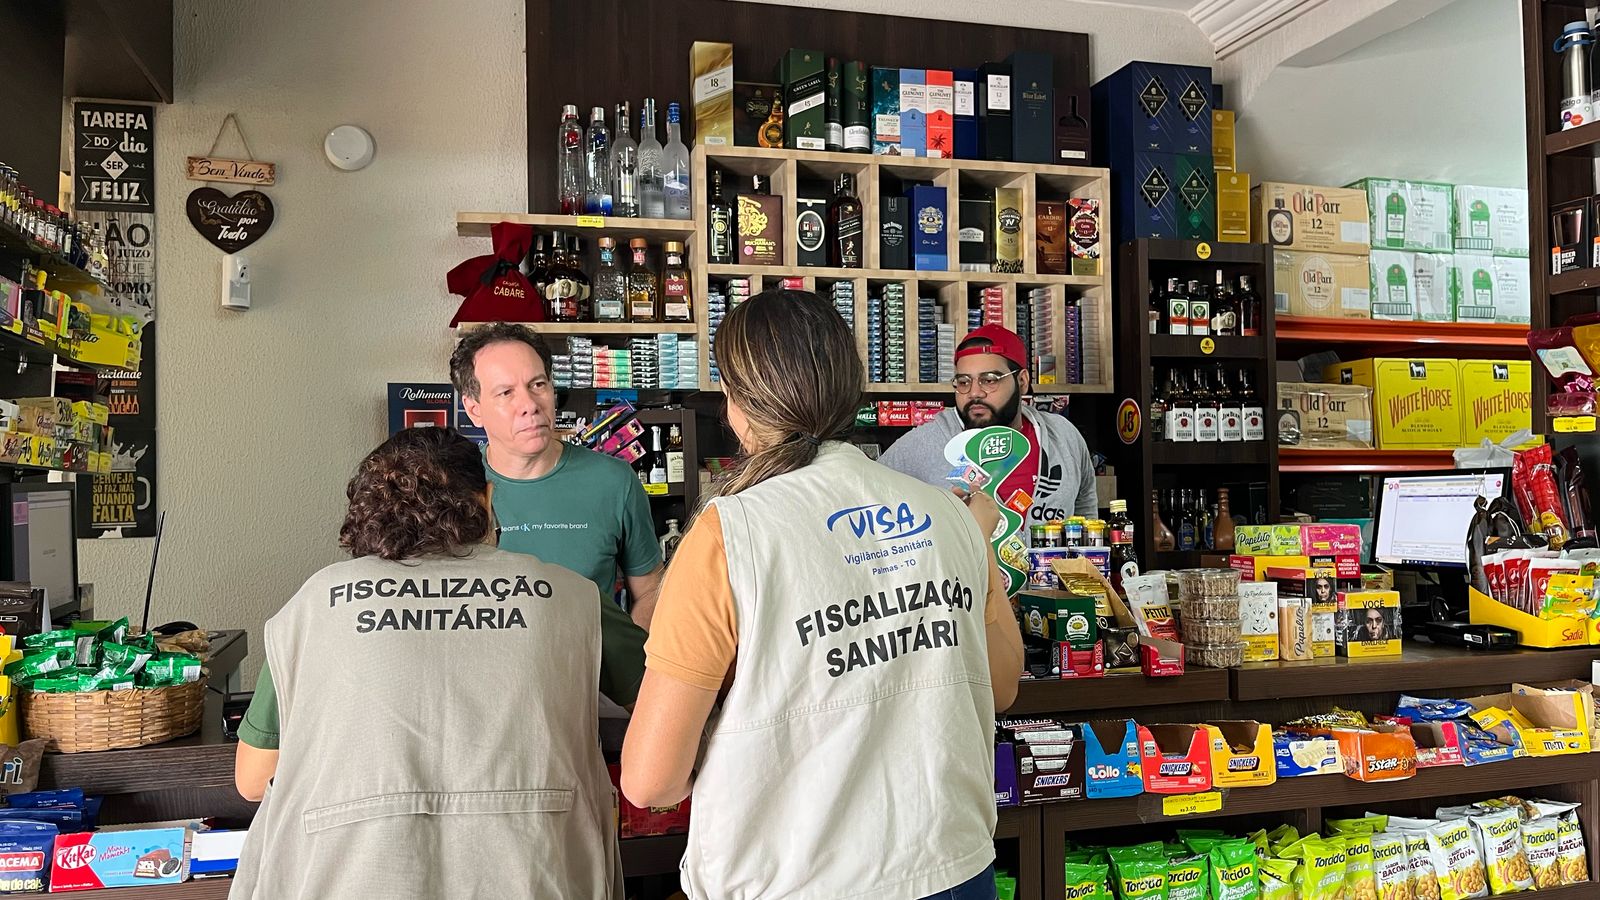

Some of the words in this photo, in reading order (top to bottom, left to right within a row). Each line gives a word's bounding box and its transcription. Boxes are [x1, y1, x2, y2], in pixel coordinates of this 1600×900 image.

[710, 77, 719, 87] 18
[808, 79, 821, 89] LABEL
[80, 110, 148, 130] TAREFA
[94, 136, 110, 147] DO
[119, 131, 148, 153] dia
[106, 159, 124, 170] SER
[230, 162, 265, 180] Vindo
[90, 181, 141, 201] FELIZ
[1293, 192, 1313, 215] Old
[1315, 193, 1341, 215] Parr
[237, 217, 259, 227] por
[1311, 218, 1323, 229] 12
[217, 225, 248, 241] Tudo
[1303, 271, 1316, 284] Old
[1316, 271, 1332, 284] Parr
[398, 387, 452, 401] Rothmans
[1300, 392, 1319, 414] Old
[1320, 391, 1346, 415] Parr
[1388, 391, 1420, 429] WHITE
[1421, 386, 1452, 412] HORSE
[1472, 396, 1503, 430] WHITE
[1124, 411, 1134, 432] 18
[1318, 417, 1328, 428] 12
[991, 436, 1007, 447] tic
[985, 446, 1006, 455] tac
[93, 473, 134, 484] CERVEJA
[104, 485, 117, 493] FAZ
[119, 484, 134, 493] MAL
[93, 493, 135, 505] QUANDO
[93, 506, 134, 522] FALTA
[1031, 504, 1064, 520] das
[848, 503, 915, 539] VISA
[1237, 531, 1270, 547] Papelito
[844, 549, 890, 565] Vigilância
[891, 539, 934, 555] Sanitária
[872, 562, 899, 576] Palmas
[905, 559, 917, 567] TO
[329, 576, 553, 608] FISCALIZAÇÃO
[1362, 598, 1384, 608] VOCÊ
[356, 604, 528, 634] SANITÁRIA
[1294, 608, 1305, 657] Papelito
[1562, 628, 1583, 641] Sadia
[1161, 763, 1189, 773] SNICKERS
[1227, 756, 1256, 767] SNICKERS
[1368, 757, 1398, 772] 5Star
[1035, 774, 1069, 786] SNICKERS
[1088, 765, 1120, 780] Lollo
[1525, 831, 1556, 844] Torcida
[60, 844, 95, 868] KitKat
[1530, 850, 1556, 861] BACON
[1382, 865, 1407, 879] BACON
